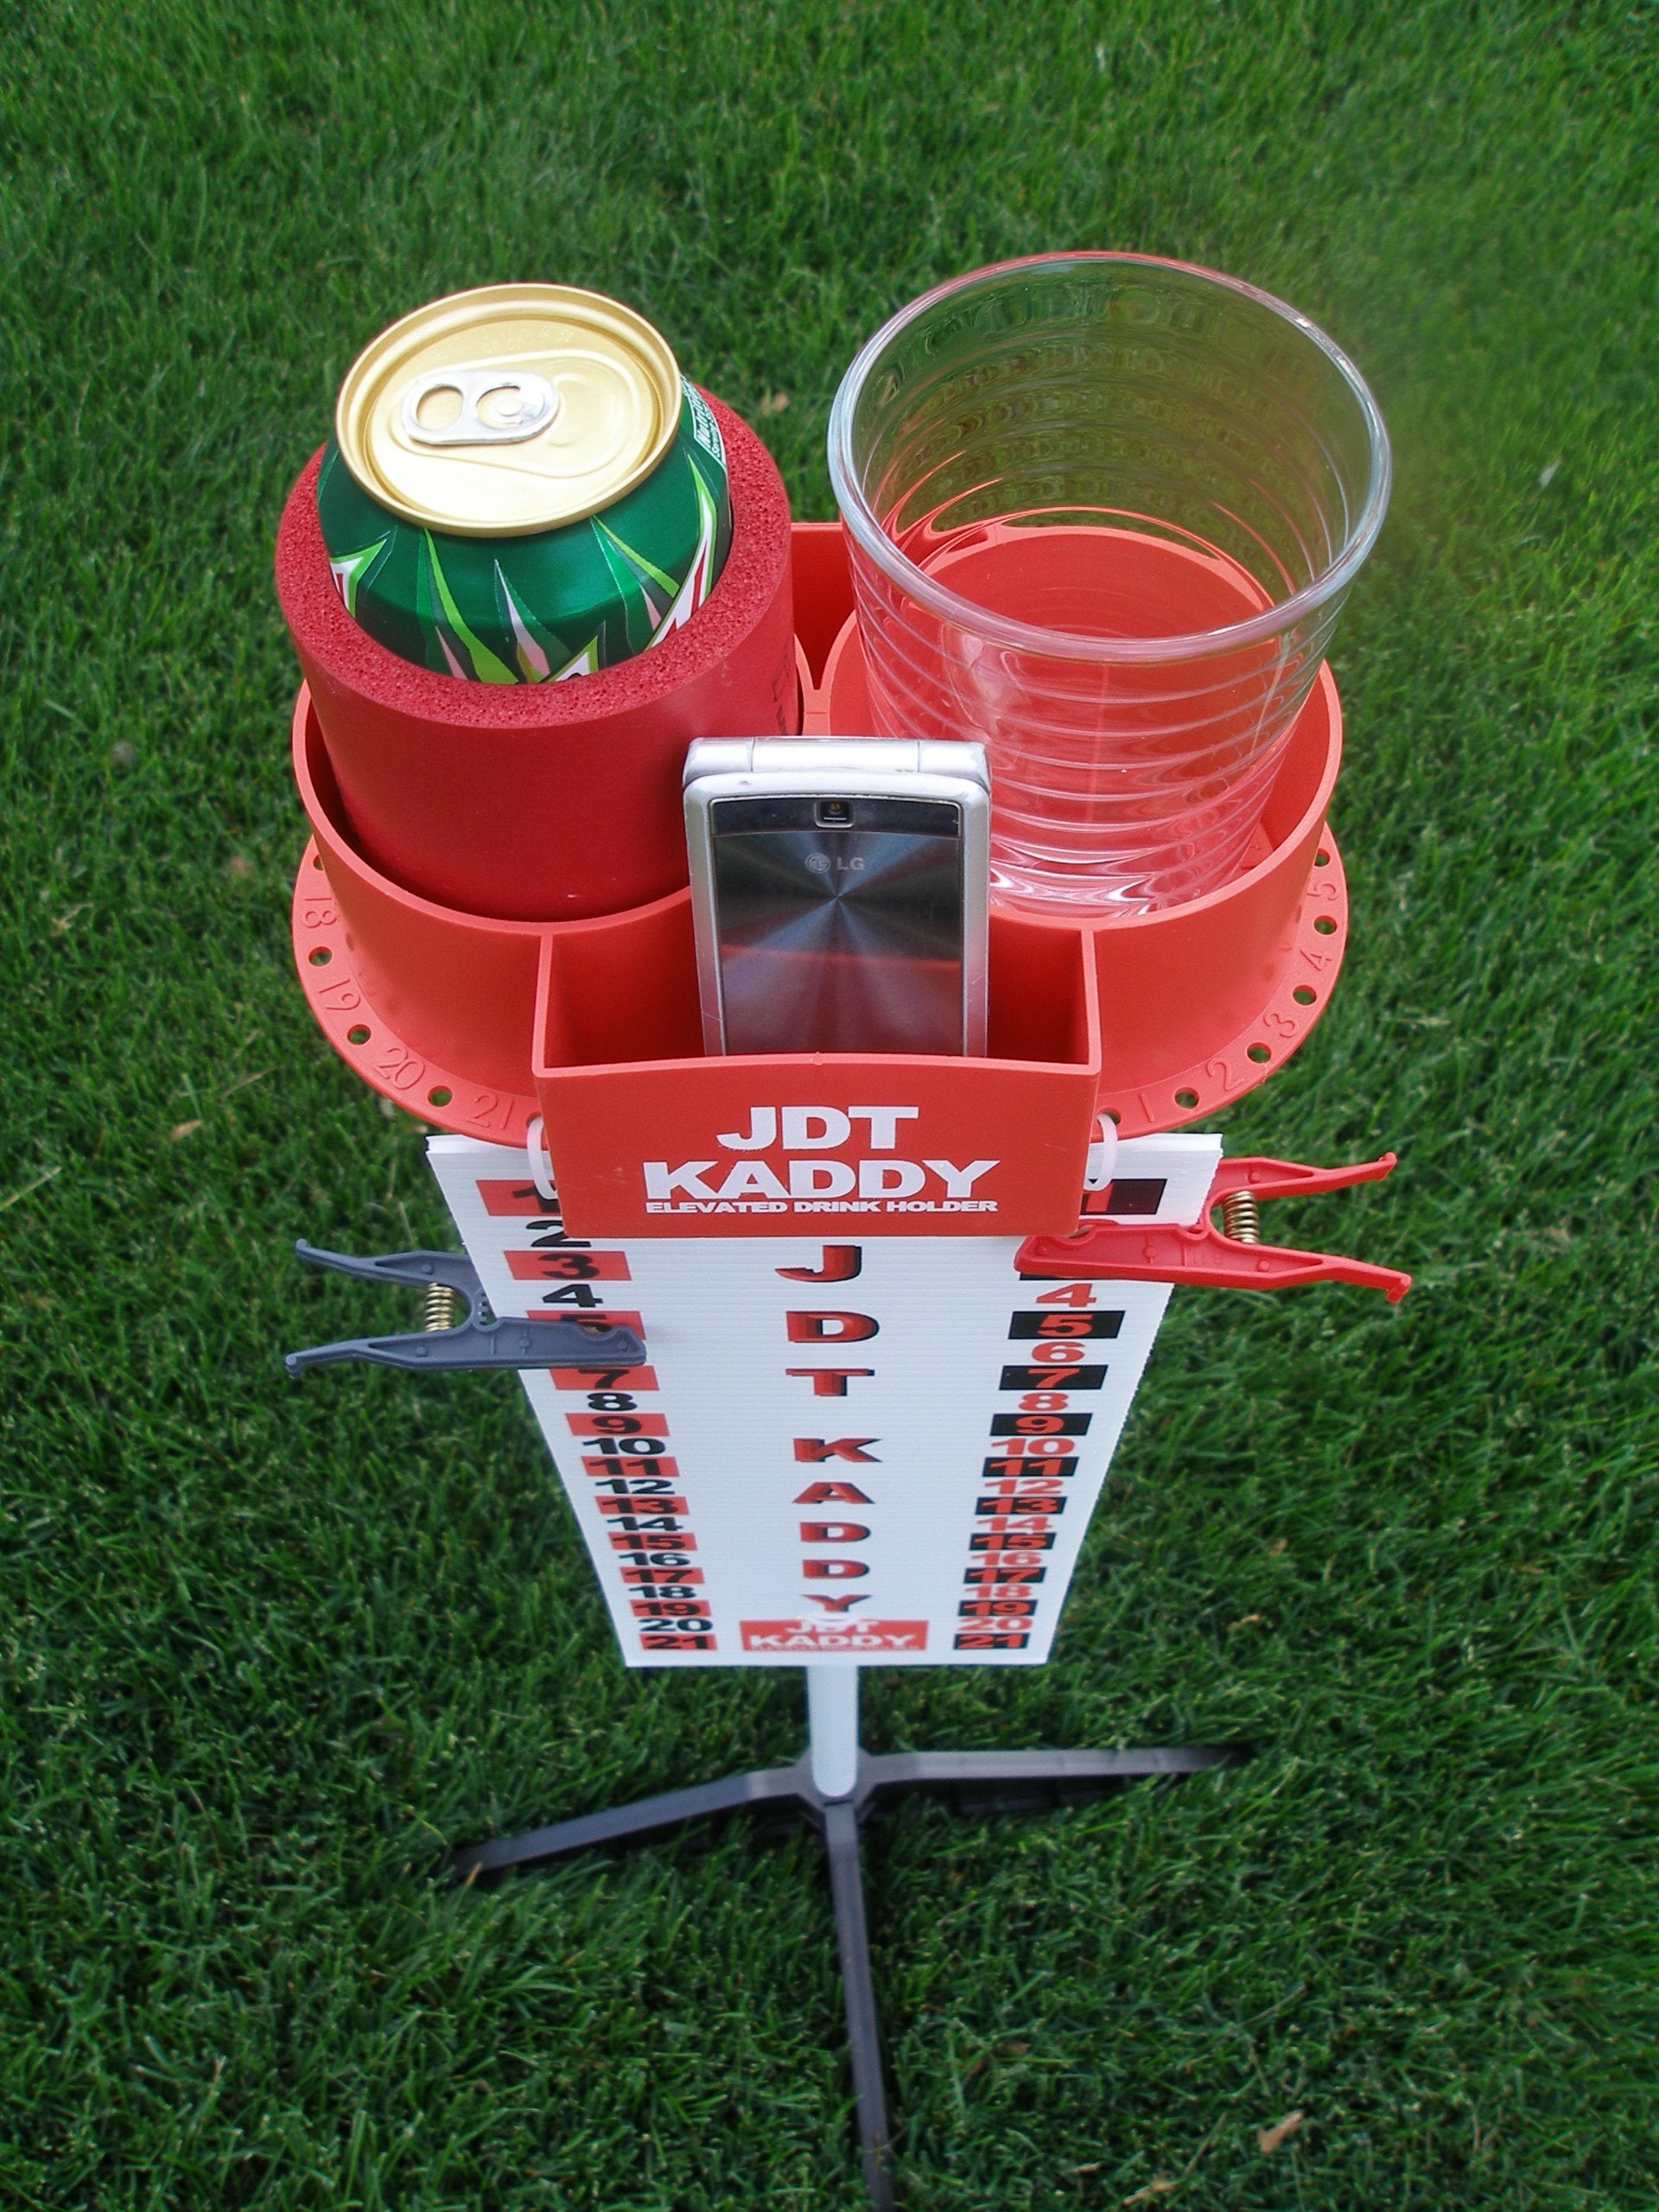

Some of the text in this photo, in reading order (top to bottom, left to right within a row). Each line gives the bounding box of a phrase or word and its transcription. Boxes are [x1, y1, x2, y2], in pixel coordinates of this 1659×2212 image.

[837, 857, 864, 871] LG
[302, 898, 337, 929] 18
[1300, 949, 1333, 971] 4
[318, 979, 361, 1012] 19
[1262, 1013, 1296, 1038] 3
[375, 1047, 426, 1090] 20
[1206, 1058, 1244, 1091] 2
[467, 1095, 514, 1129] 21
[716, 1106, 918, 1150] JDT
[643, 1160, 1001, 1199] KADDY
[646, 1200, 998, 1214] ELEVATED DRINK HOLDER
[525, 1220, 591, 1247] 2
[538, 1253, 600, 1279] 3
[542, 1284, 603, 1307] 4
[1035, 1283, 1097, 1307] 4
[1037, 1313, 1093, 1337] 5
[1032, 1341, 1085, 1363] 6
[578, 1369, 630, 1389] 7
[1027, 1368, 1079, 1389] 7
[587, 1392, 638, 1411] 8
[1018, 1392, 1069, 1411] 8
[591, 1415, 642, 1434] 9
[1015, 1415, 1065, 1434] 9
[582, 1438, 666, 1455] 10
[991, 1438, 1075, 1455] 10
[589, 1459, 661, 1476] 11
[989, 1459, 1062, 1476] 11
[595, 1478, 675, 1495] 12
[984, 1478, 1064, 1495] 12
[602, 1498, 678, 1514] 13
[982, 1497, 1058, 1514] 13
[607, 1516, 683, 1531] 14
[976, 1516, 1052, 1531] 14
[613, 1535, 686, 1549] 15
[974, 1535, 1047, 1549] 15
[619, 1553, 690, 1566] 16
[971, 1551, 1042, 1566] 16
[625, 1569, 693, 1583] 17
[969, 1568, 1040, 1583] 17
[628, 1586, 696, 1599] 18
[964, 1585, 1032, 1599] 18
[635, 1602, 701, 1616] 19
[963, 1601, 1030, 1616] 19
[638, 1618, 714, 1632] 20
[957, 1616, 1033, 1631] 20
[645, 1636, 709, 1649] 21
[748, 1634, 916, 1646] KADDY
[957, 1634, 1023, 1649] 21
